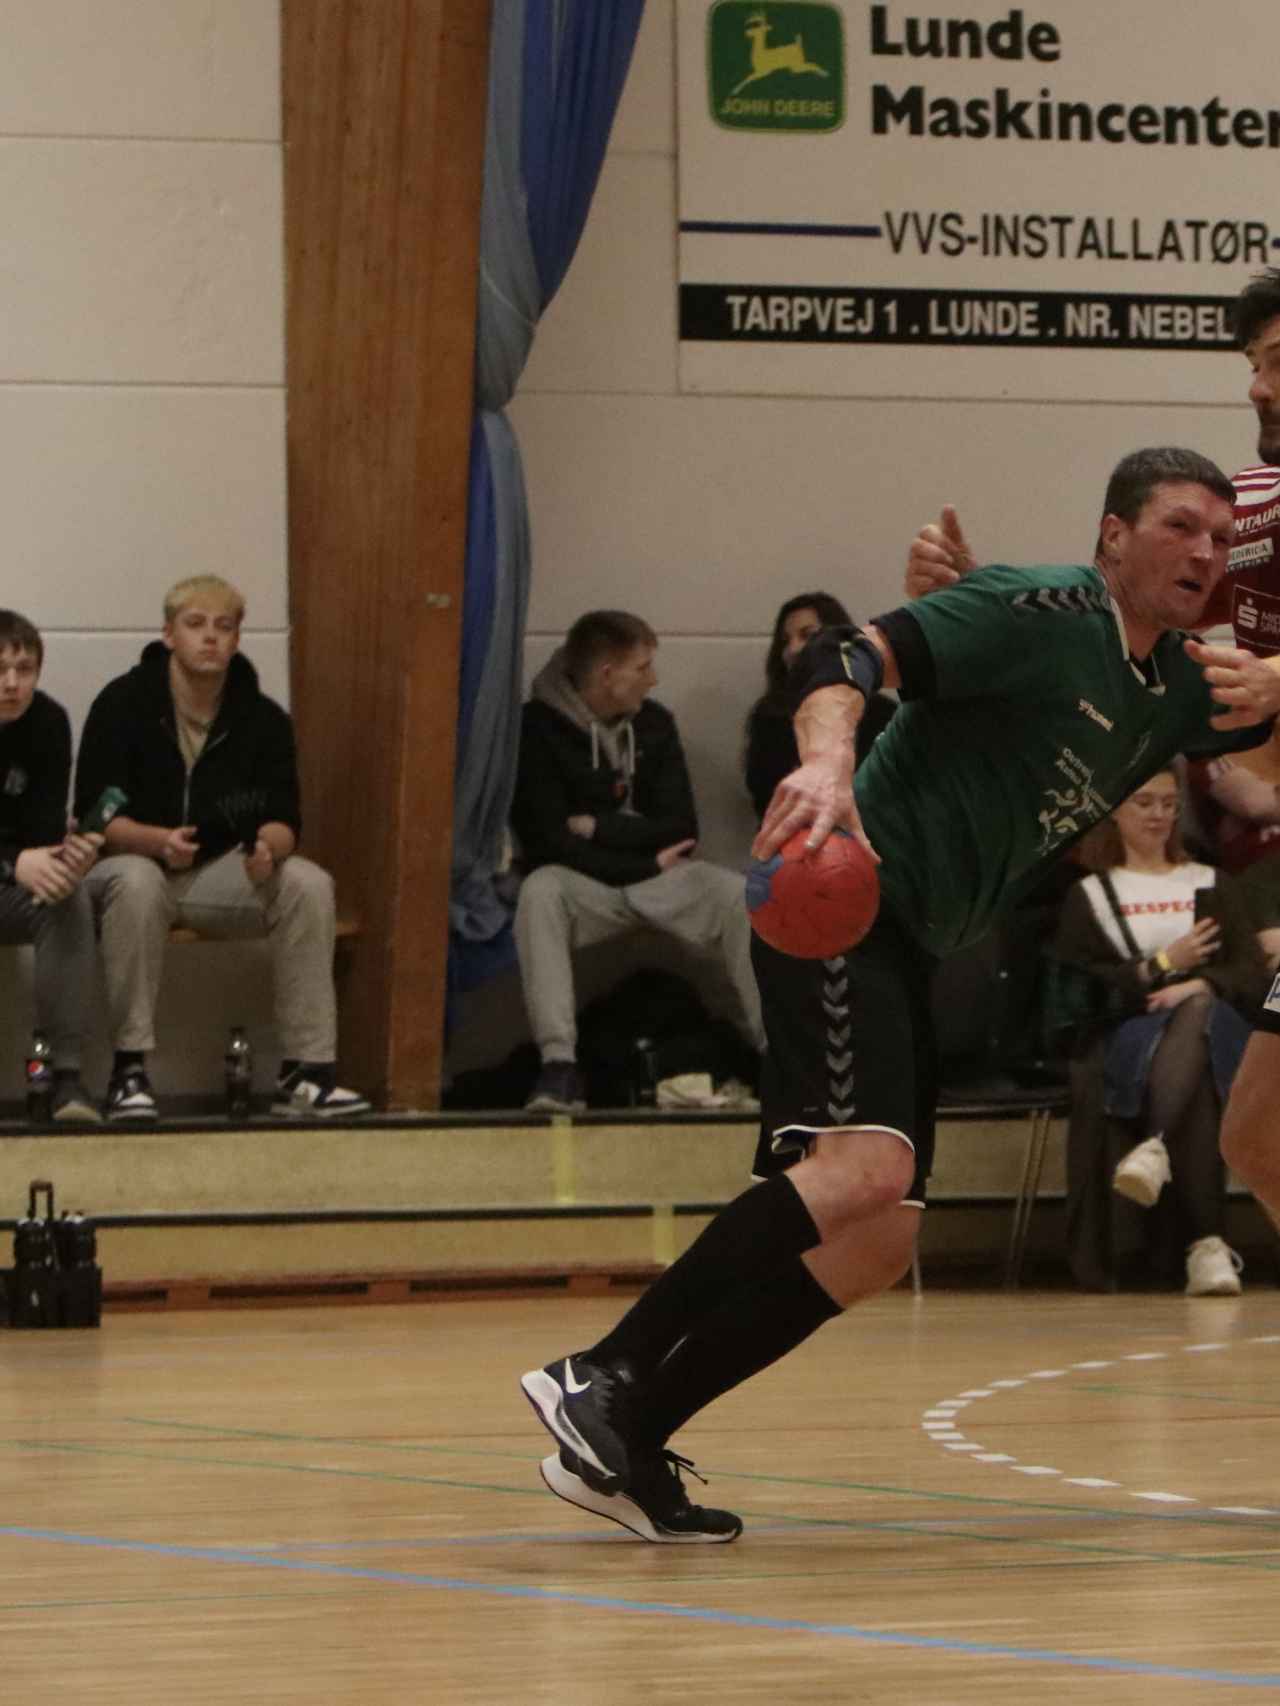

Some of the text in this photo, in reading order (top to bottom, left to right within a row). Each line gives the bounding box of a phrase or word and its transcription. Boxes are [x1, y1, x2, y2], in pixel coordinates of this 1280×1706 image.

[870, 5, 1062, 62] Lunde
[720, 99, 836, 117] JOHN DEERE
[884, 210, 1270, 264] VVS-INSTALLATØR
[726, 295, 875, 333] TARPVEJ
[1064, 303, 1119, 338] NR.
[1129, 306, 1236, 341] NEBEL
[1119, 899, 1197, 916] RESPEC
